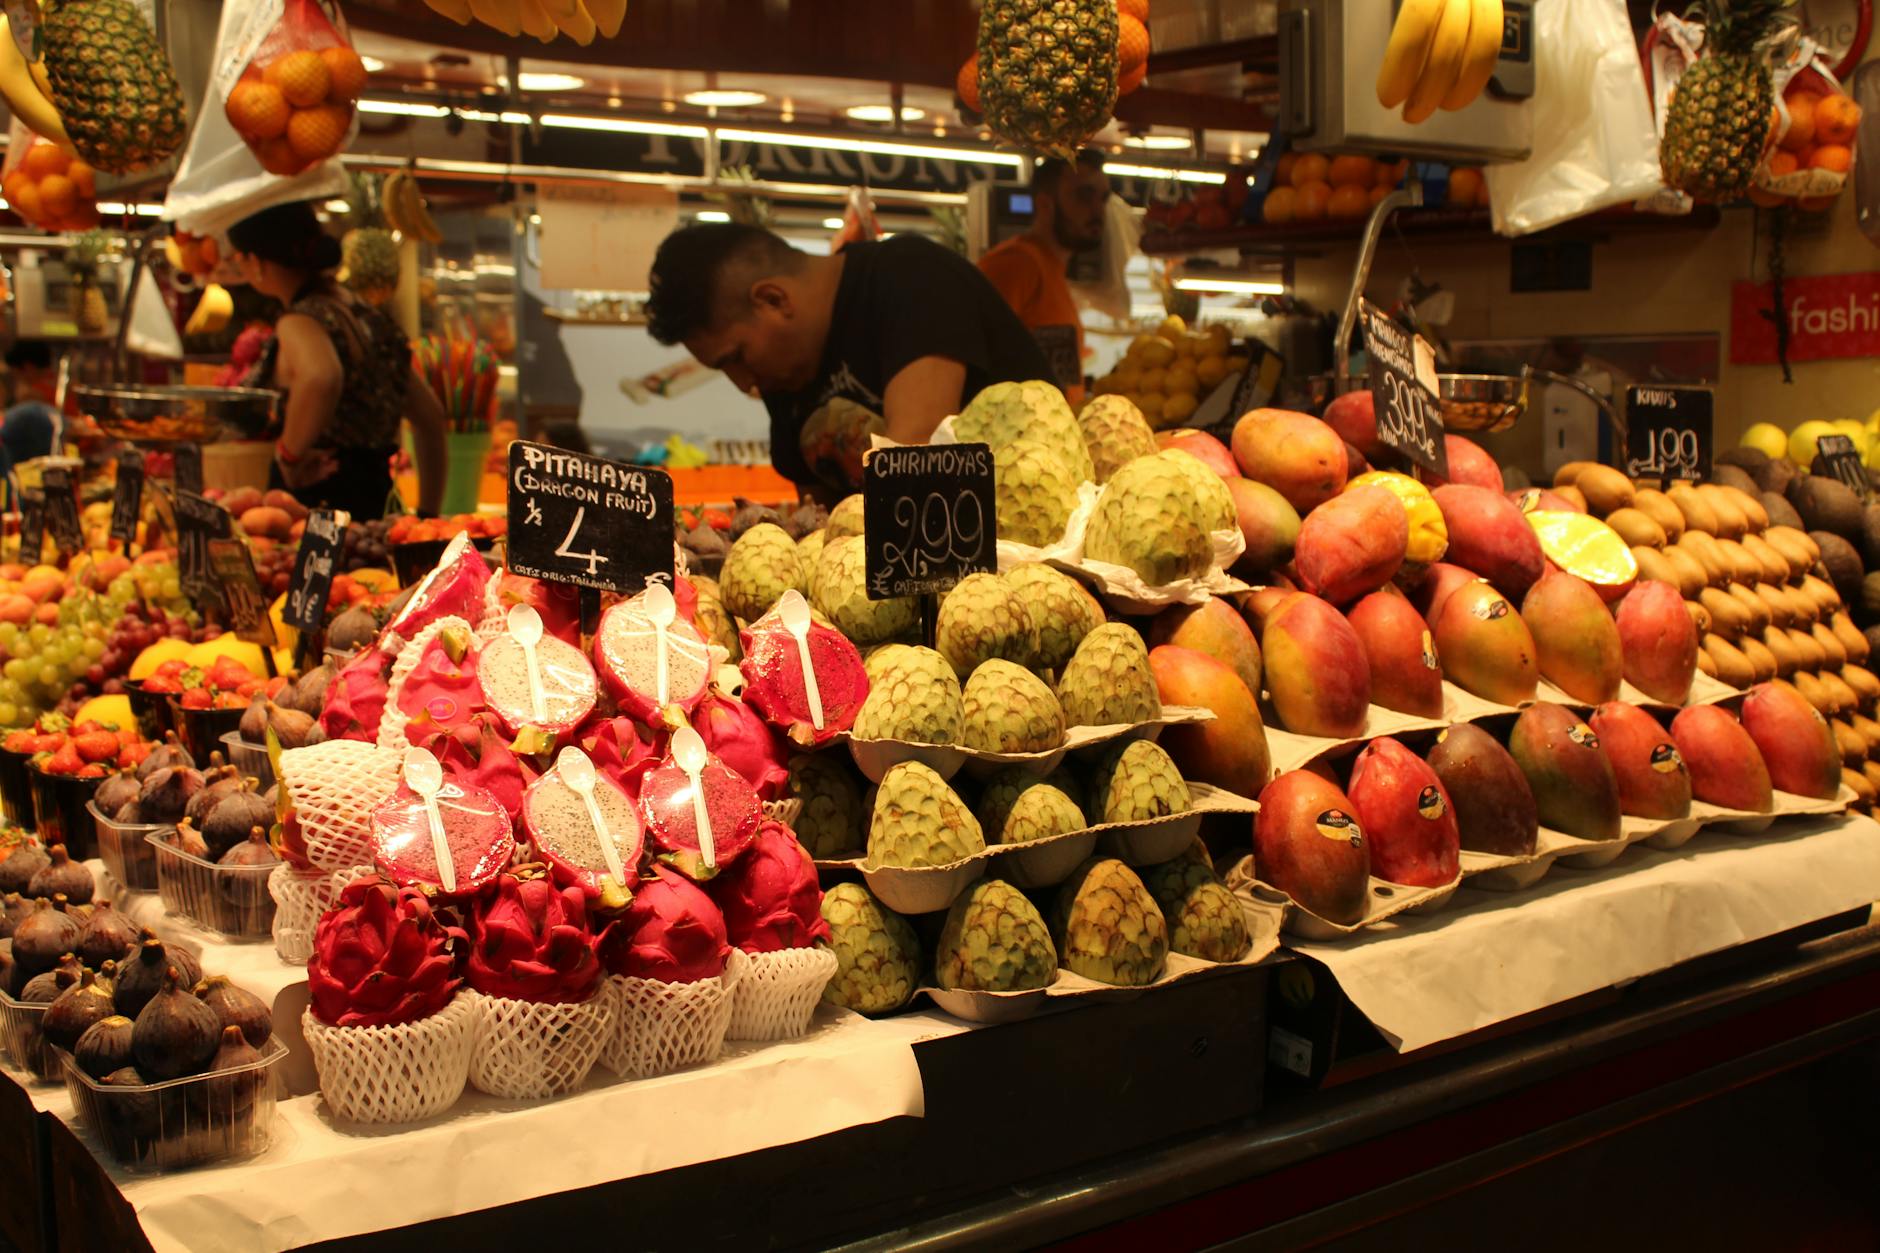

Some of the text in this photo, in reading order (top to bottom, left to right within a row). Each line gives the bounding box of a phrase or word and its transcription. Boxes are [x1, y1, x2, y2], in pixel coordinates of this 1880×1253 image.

[1791, 293, 1880, 335] fashi
[514, 466, 599, 504] (DRAGON
[522, 446, 648, 494] PITAHAYA
[874, 450, 989, 479] CHIRIMOYAS
[555, 506, 609, 575] 4
